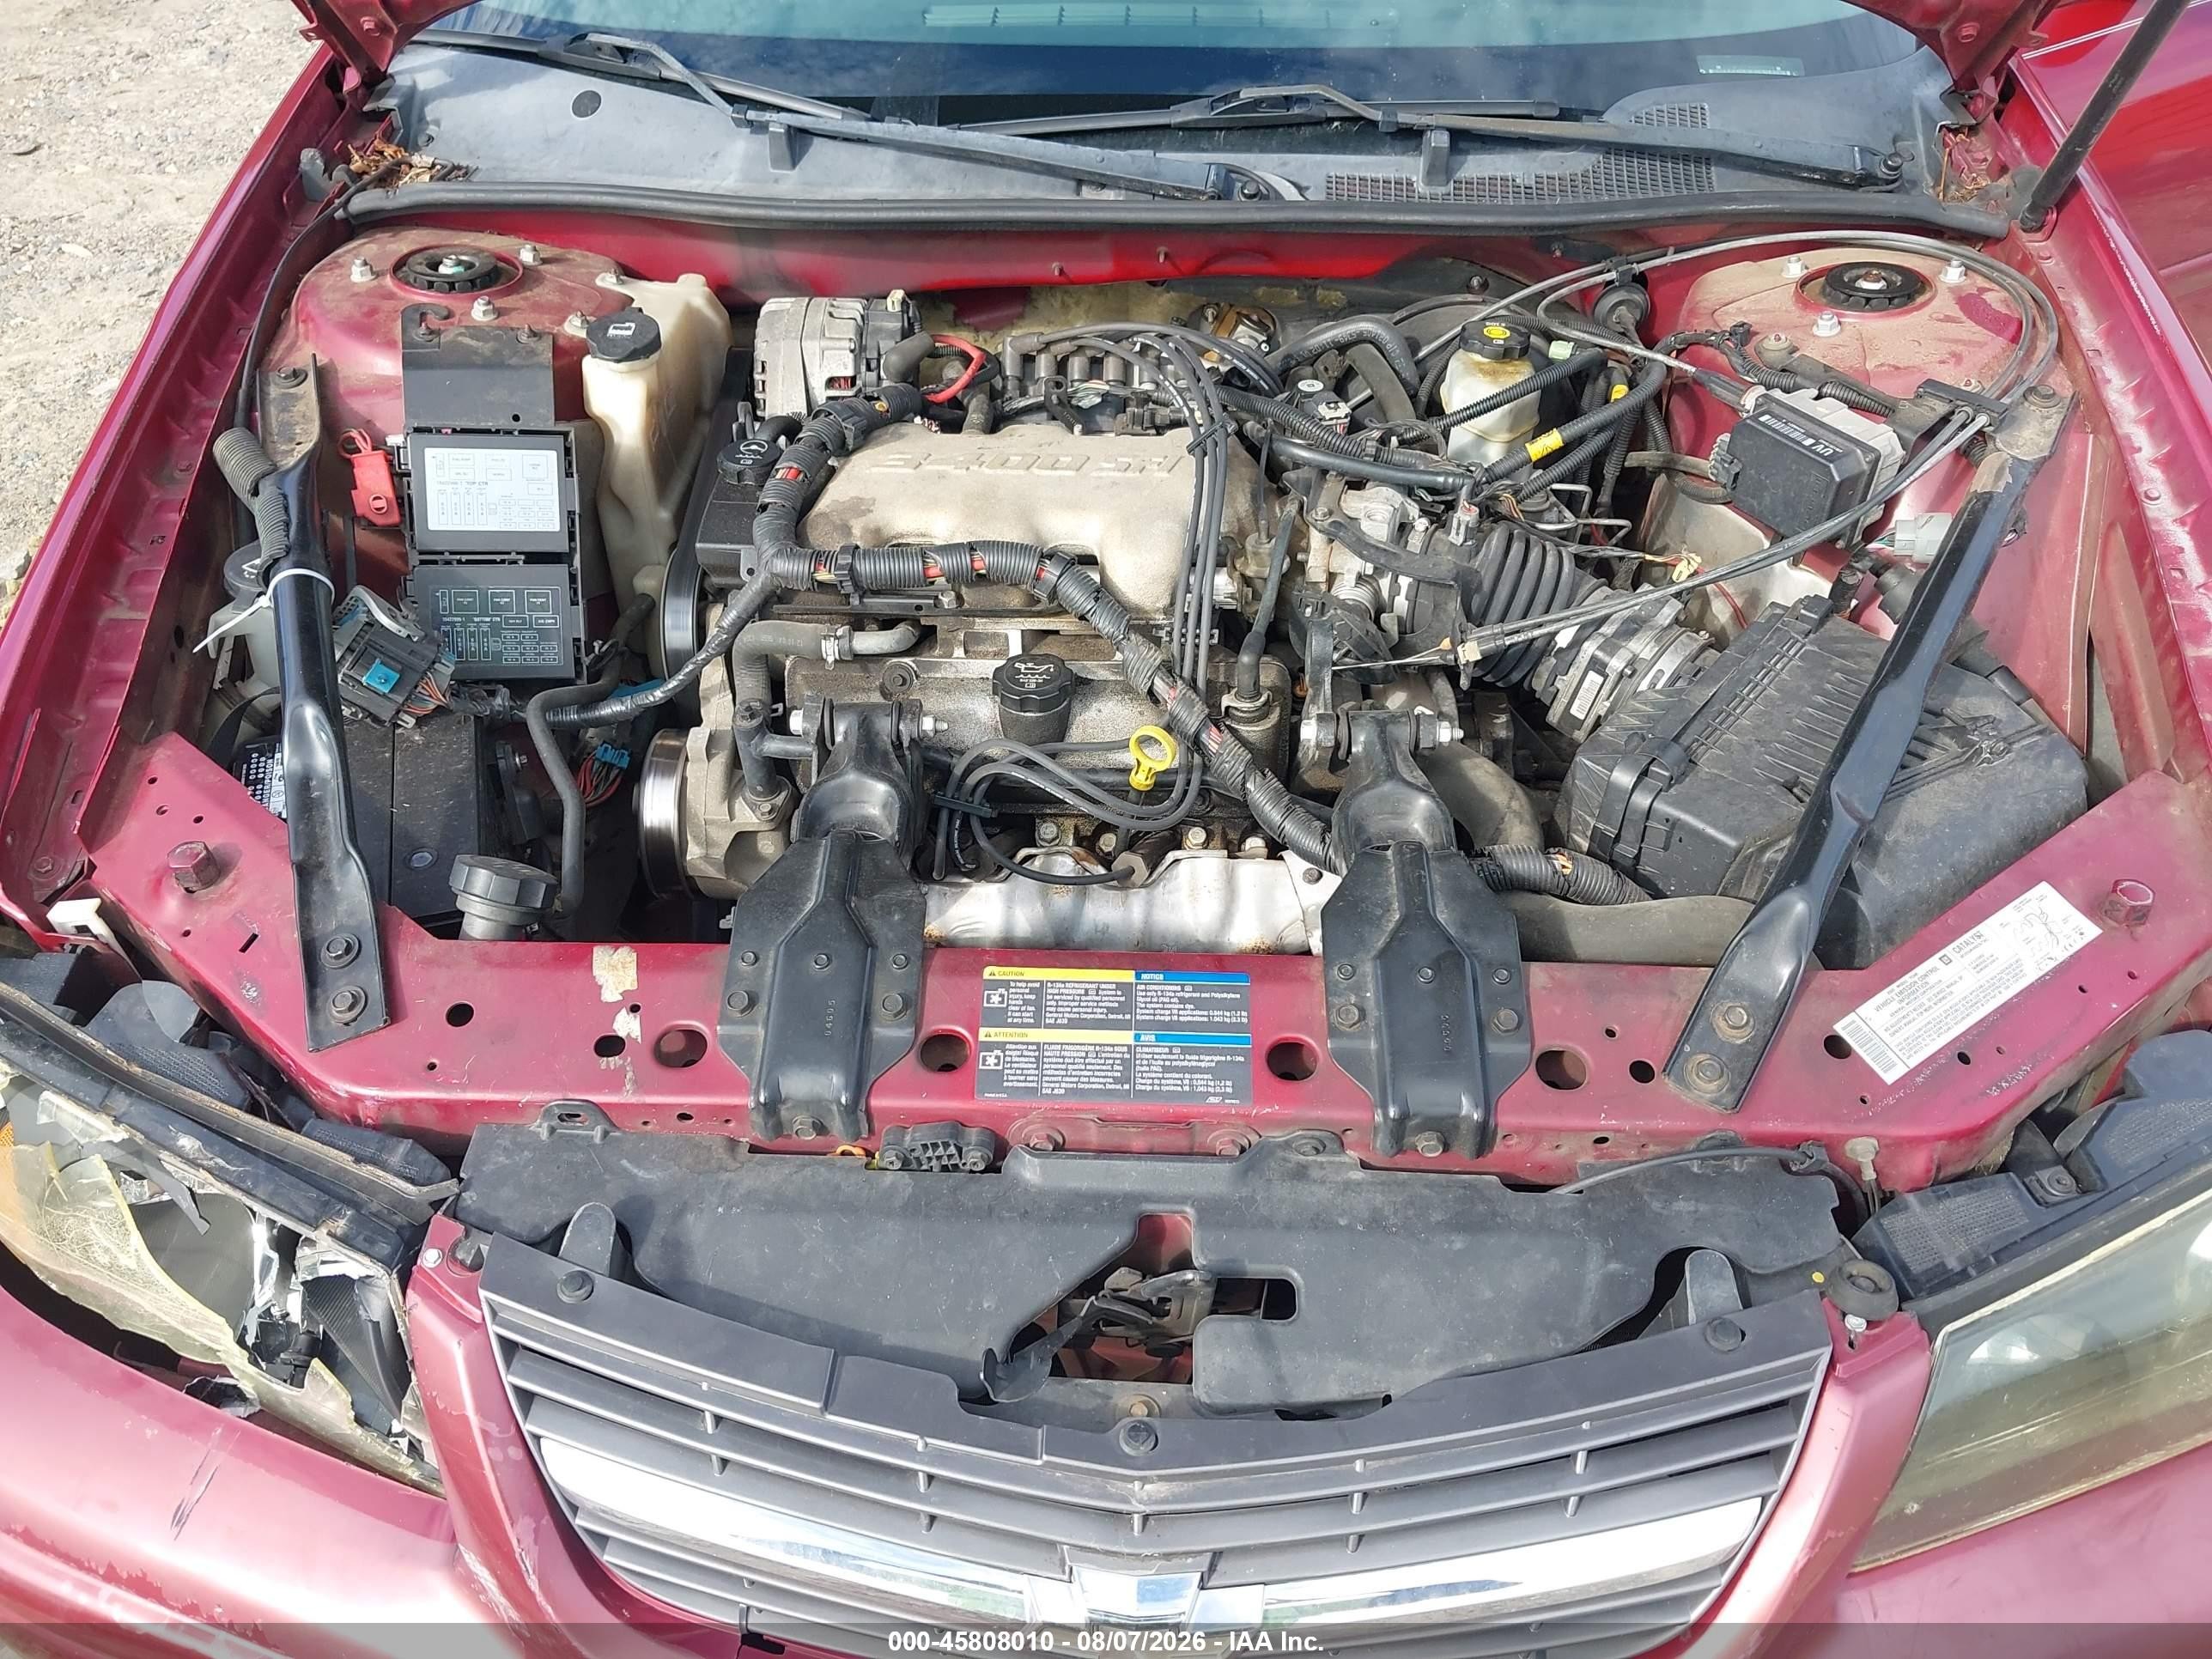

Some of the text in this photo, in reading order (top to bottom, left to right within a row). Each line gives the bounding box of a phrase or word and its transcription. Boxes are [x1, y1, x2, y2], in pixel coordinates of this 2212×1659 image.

[864, 453, 1091, 473] 3400
[262, 758, 274, 810] ANGER/POISON
[1951, 930, 1985, 955] CATALYST
[1874, 995, 1897, 1012] VEHICLE
[1893, 979, 1919, 998] EMISSION
[1916, 965, 1940, 982] CONTROL
[1895, 980, 1930, 1005] INFORMATION
